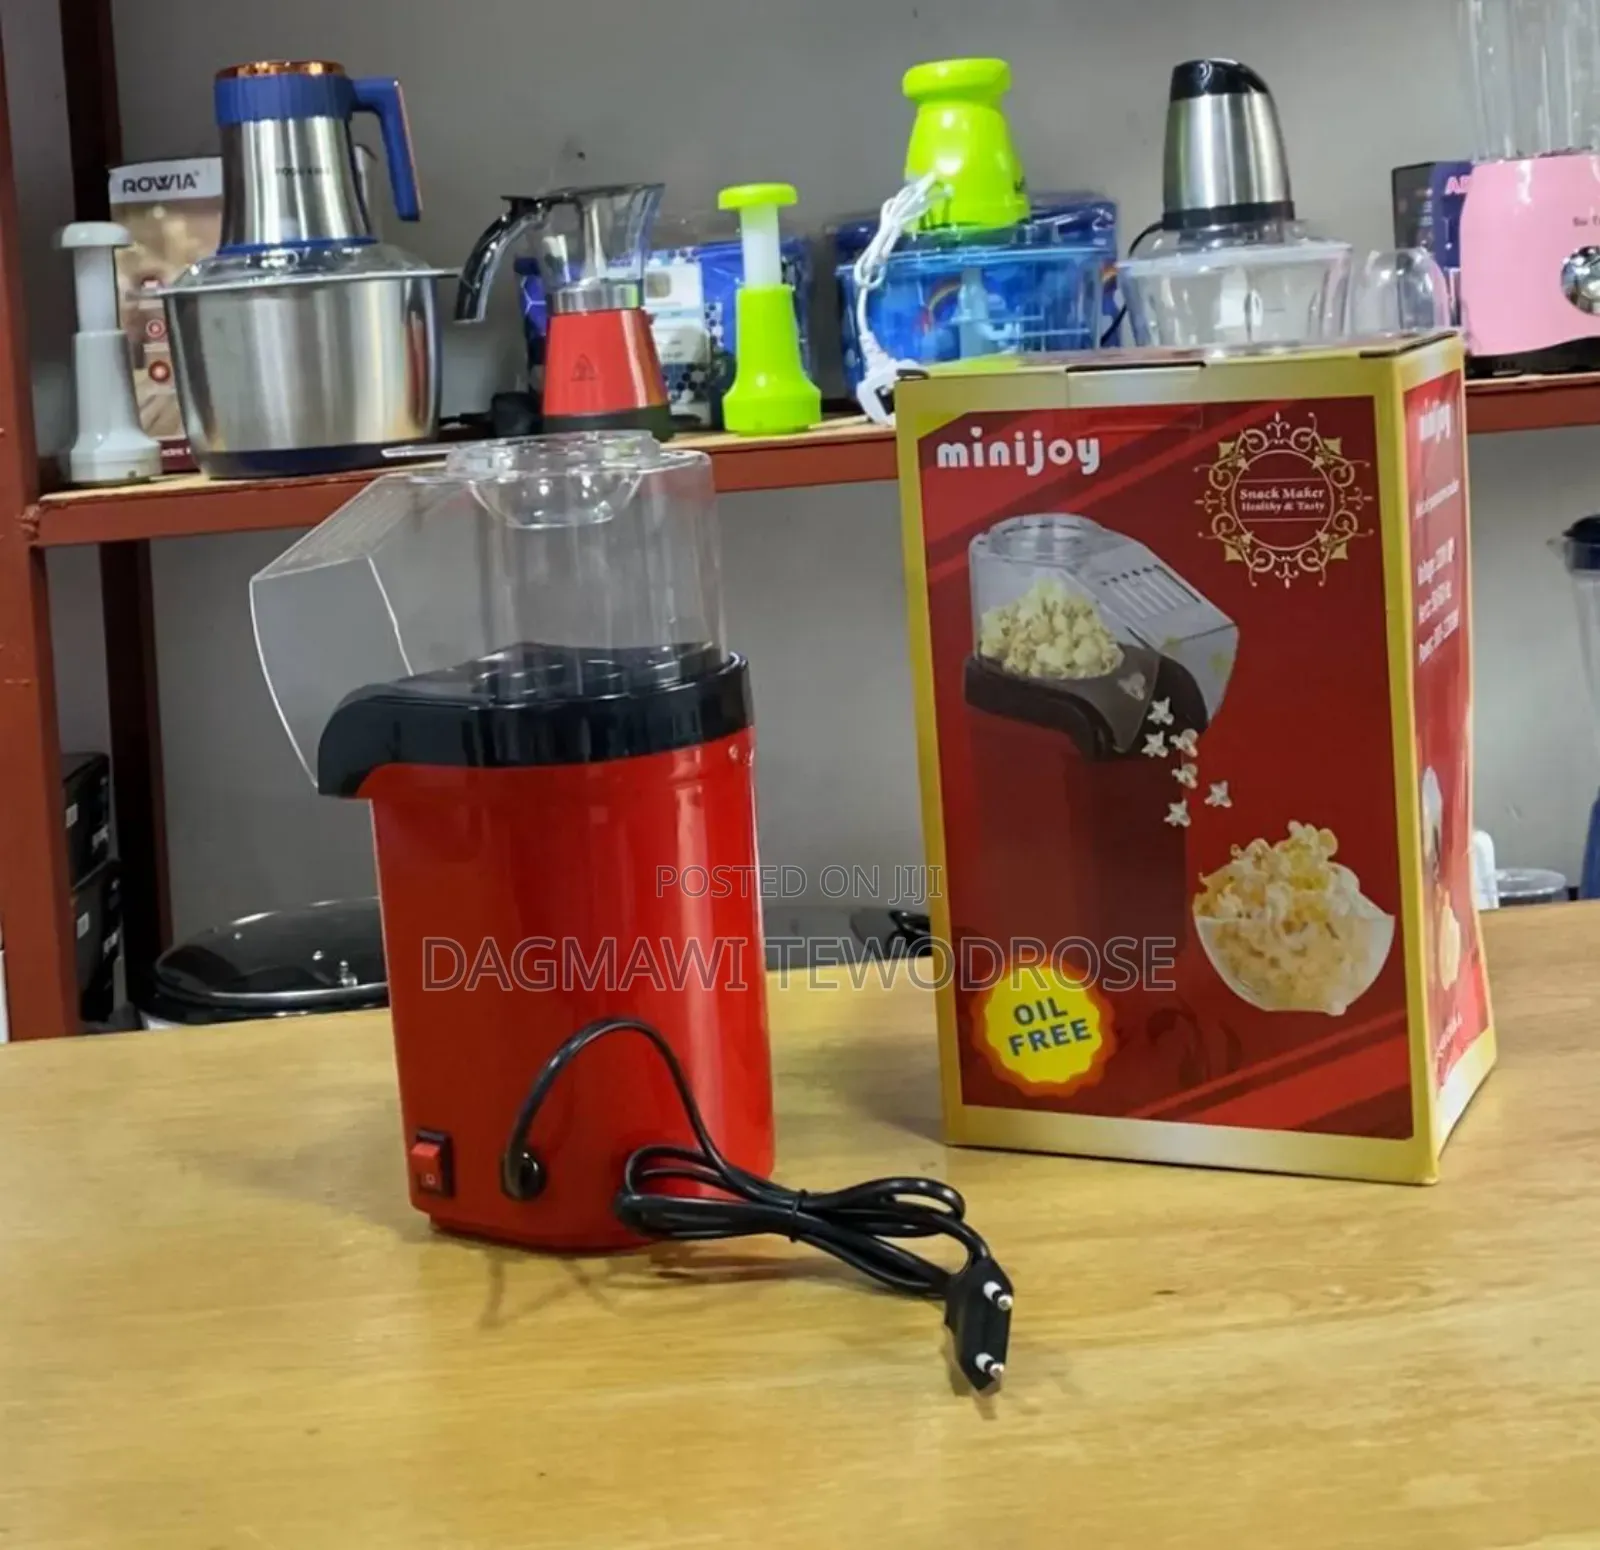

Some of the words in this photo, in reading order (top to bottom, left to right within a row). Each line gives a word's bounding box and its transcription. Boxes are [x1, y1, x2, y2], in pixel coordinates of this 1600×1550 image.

[122, 172, 198, 194] ROWIA
[936, 425, 1100, 477] minijoy
[1239, 486, 1280, 501] Snack
[1281, 486, 1325, 499] Maker
[1241, 501, 1282, 514] Healthy
[1283, 502, 1294, 511] &
[1296, 500, 1325, 513] Tasty
[1012, 996, 1069, 1026] OIL
[1007, 1017, 1093, 1057] FREE
